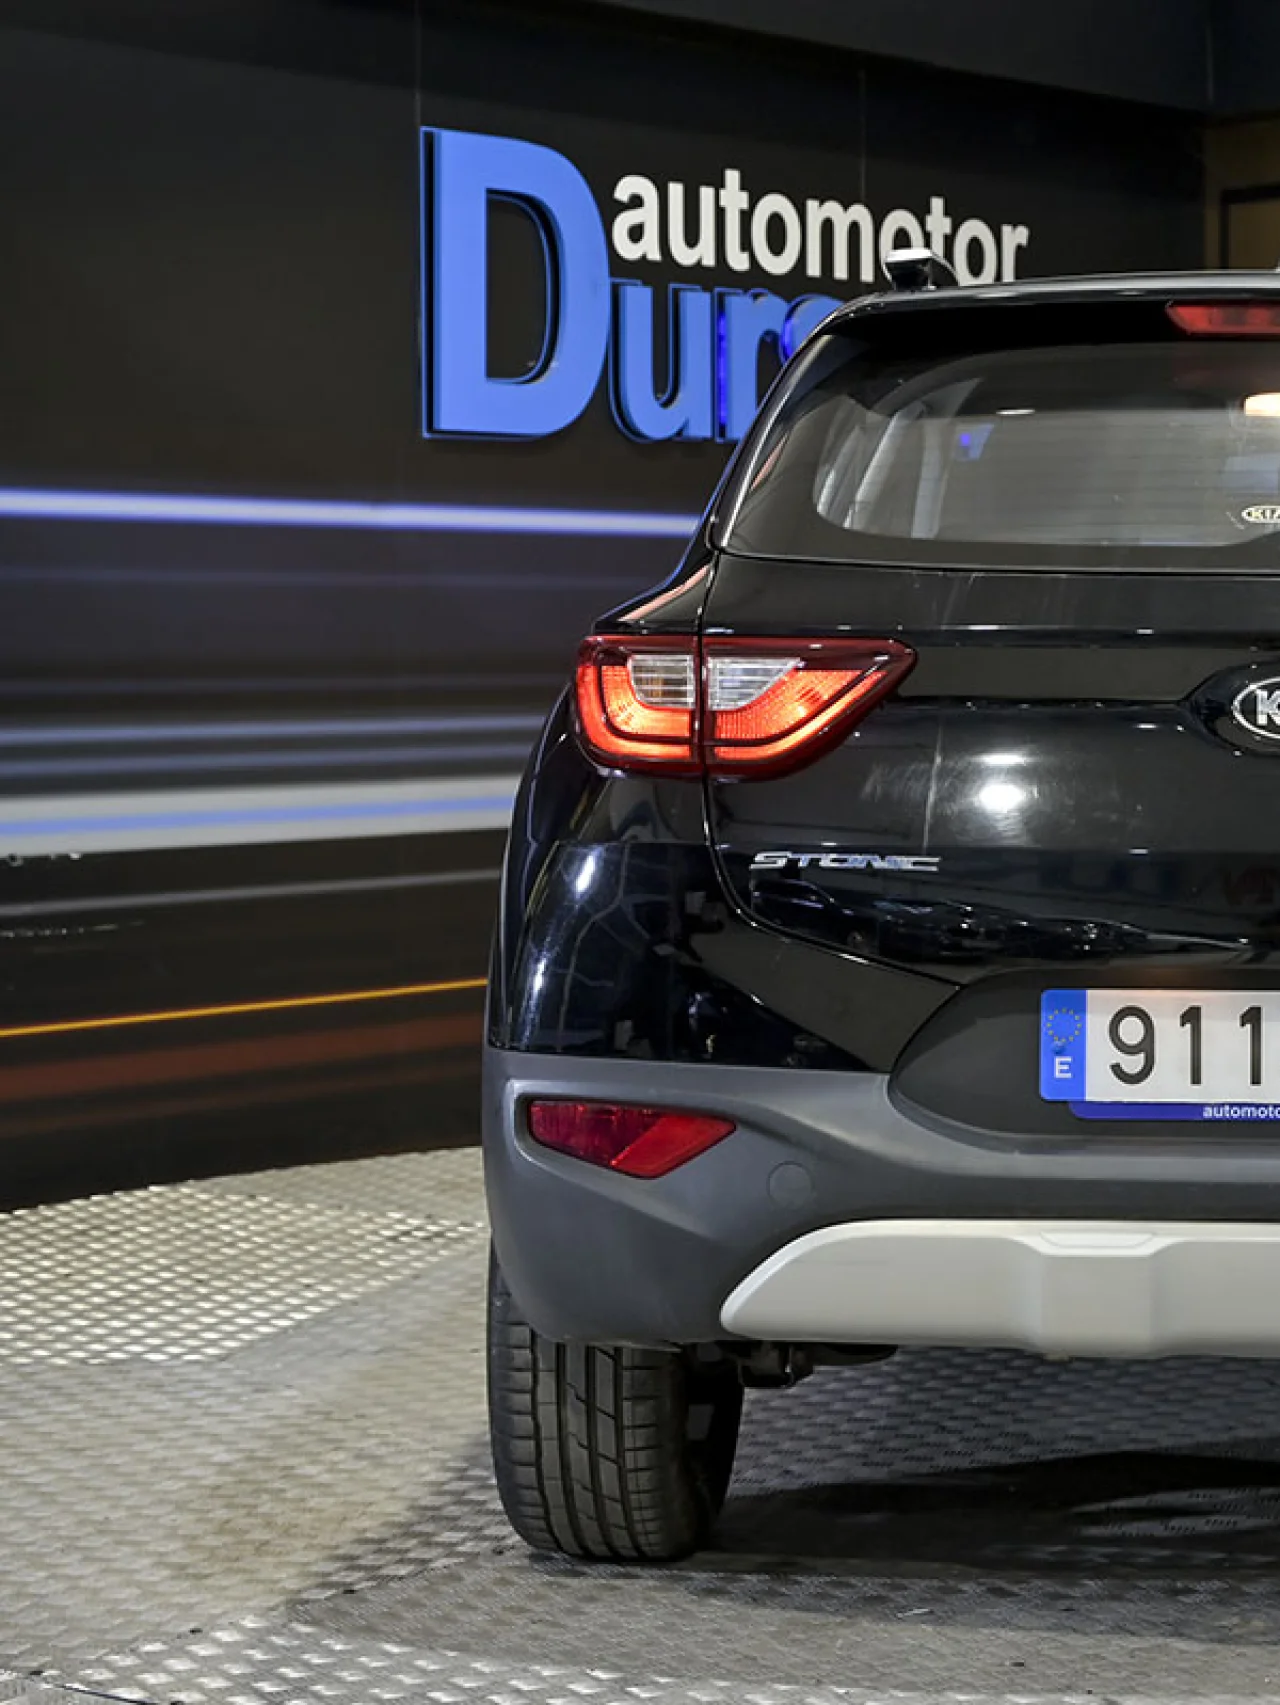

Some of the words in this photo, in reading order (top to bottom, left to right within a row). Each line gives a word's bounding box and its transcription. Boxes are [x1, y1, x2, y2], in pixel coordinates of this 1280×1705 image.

[613, 168, 1029, 285] automotor
[750, 851, 941, 872] STONIC
[1054, 1056, 1073, 1079] E
